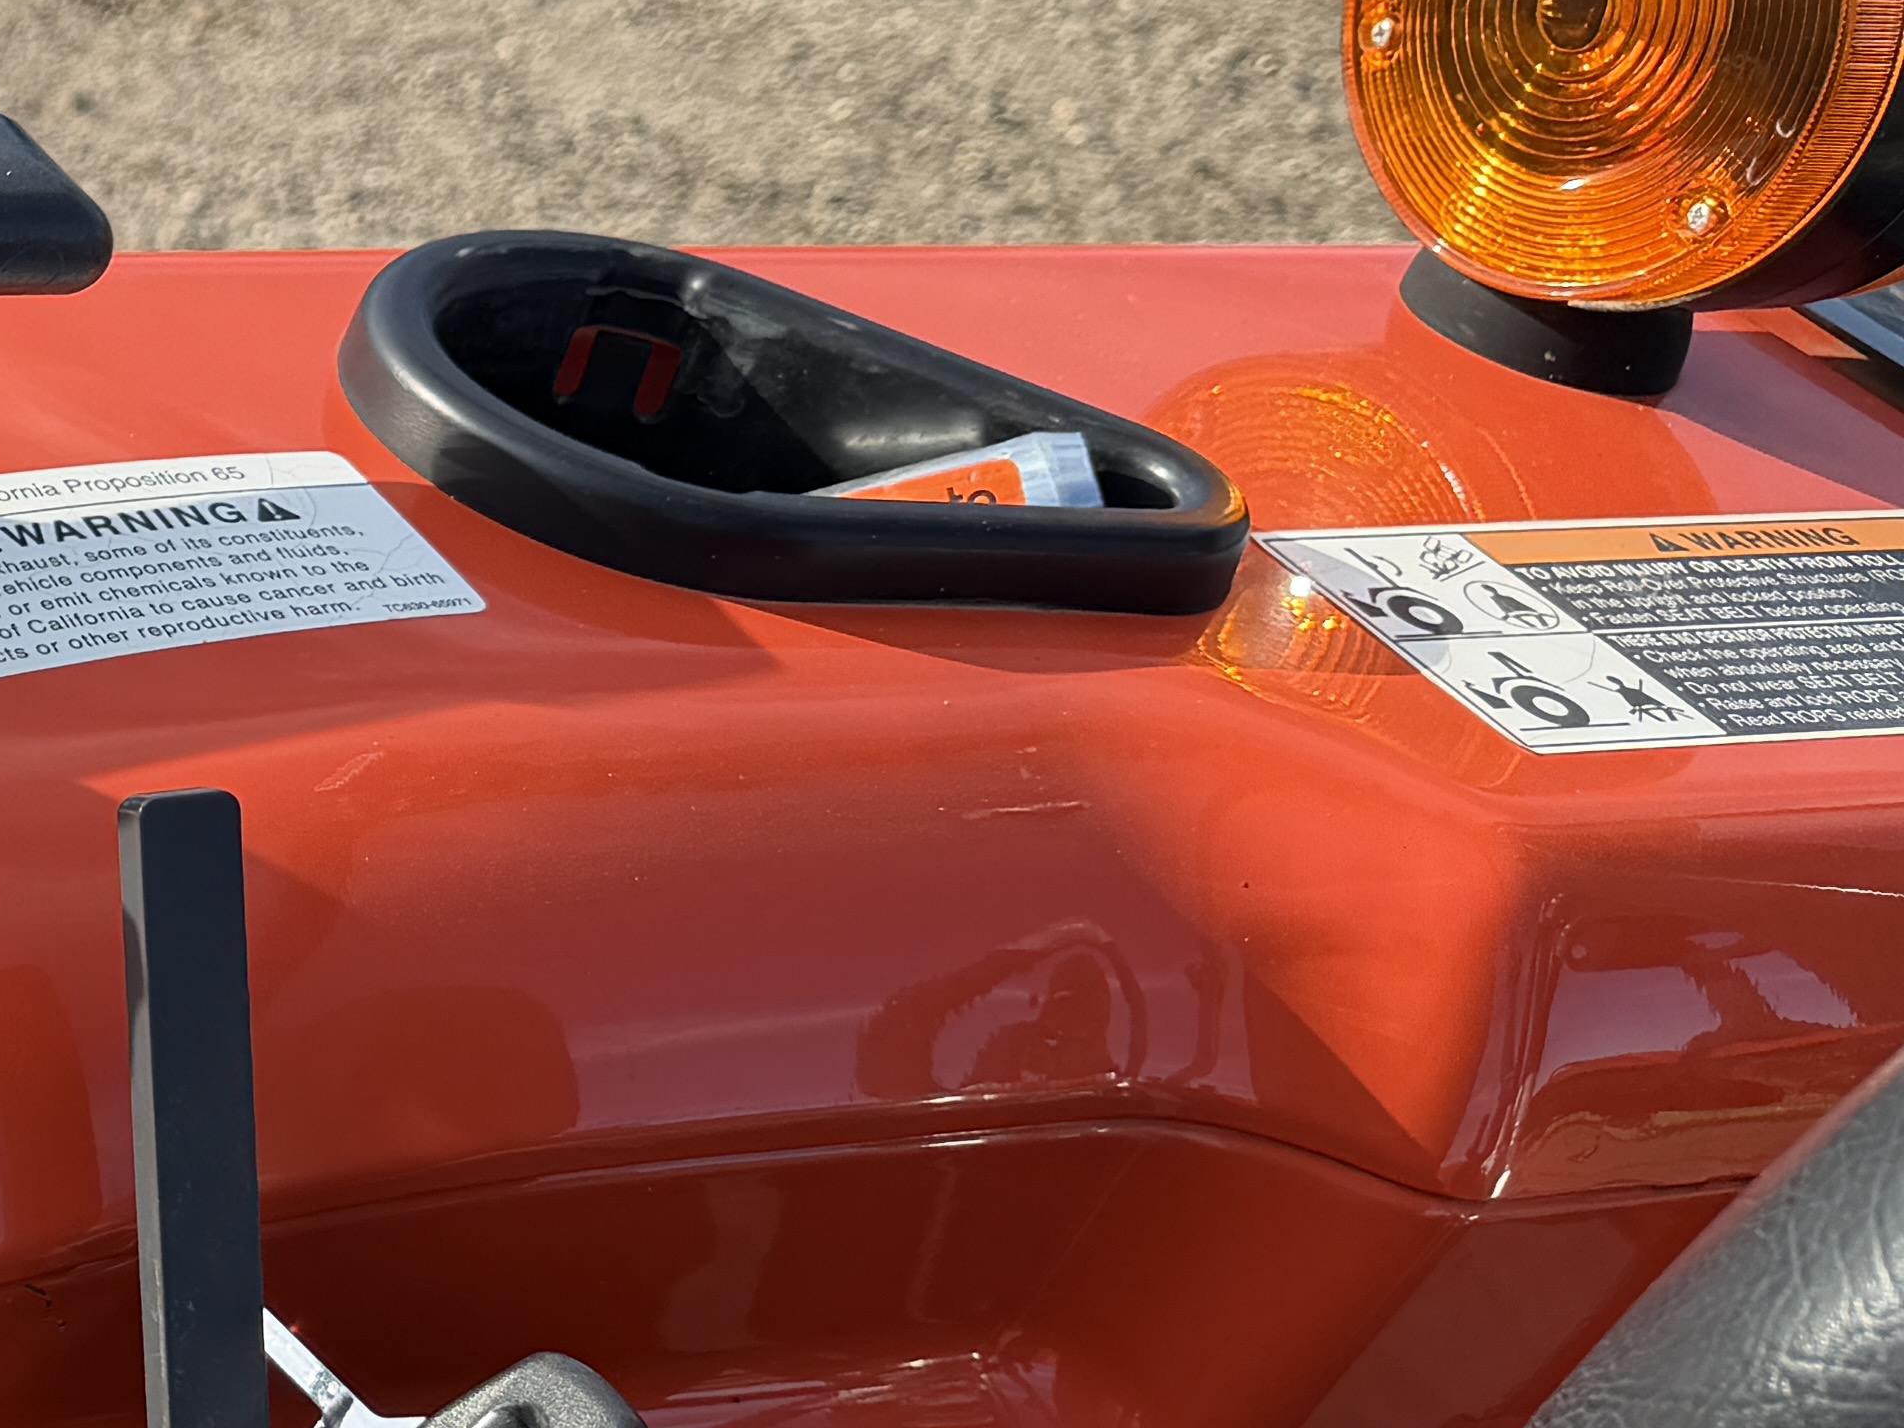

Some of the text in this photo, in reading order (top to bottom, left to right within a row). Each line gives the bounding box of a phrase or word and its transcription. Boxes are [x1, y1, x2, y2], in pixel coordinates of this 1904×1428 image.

[63, 468, 208, 494] Proposition
[210, 466, 246, 481] 65
[0, 502, 248, 547] WARNING
[84, 543, 152, 562] some
[155, 539, 178, 553] of
[183, 535, 212, 551] its
[218, 524, 365, 548] constituents,
[1677, 527, 1861, 551] WARNING
[80, 556, 223, 583] components
[228, 551, 272, 566] and
[276, 544, 350, 560] fluids,
[1514, 567, 1551, 581] TO
[1550, 564, 1617, 580] AVOID
[1612, 561, 1690, 576] INJURY
[1689, 560, 1725, 573] OR
[1720, 558, 1793, 572] DEATH
[1789, 555, 1854, 569] FROM
[8, 603, 32, 616] or
[40, 591, 93, 611] emit
[98, 574, 217, 602] chemicals
[222, 568, 297, 587] known
[302, 563, 327, 576] to
[331, 559, 370, 573] the
[1548, 582, 1604, 596] Keep
[1776, 572, 1870, 586] Structures
[1867, 568, 1904, 584] (RO
[27, 601, 145, 634] California
[149, 601, 174, 615] to
[181, 592, 252, 611] cause
[258, 585, 335, 601] cancer
[345, 577, 387, 591] and
[390, 572, 446, 588] birth
[1569, 598, 1593, 610] in
[1592, 597, 1625, 609] the
[1690, 592, 1728, 605] and
[1590, 612, 1659, 625] Fasten
[1656, 609, 1712, 622] SEAT
[1709, 605, 1763, 620] BELT
[1759, 603, 1824, 617] before
[35, 641, 60, 655] or
[68, 627, 130, 649] other
[138, 608, 286, 639] reproductive
[291, 601, 361, 619] harm.
[1643, 649, 1711, 664] Check
[1704, 648, 1740, 660] the
[1739, 644, 1830, 661] operating
[1826, 643, 1872, 654] area
[1664, 666, 1719, 679] when
[1718, 661, 1813, 677] absolutely
[1684, 672, 1904, 695] Do not wear SEAT BELT
[1705, 697, 1765, 711] Raise
[1763, 694, 1803, 708] and
[1797, 692, 1842, 706] lock
[1835, 688, 1899, 704] ROPS
[1727, 713, 1786, 727] Read
[1781, 709, 1847, 724] ROPS
